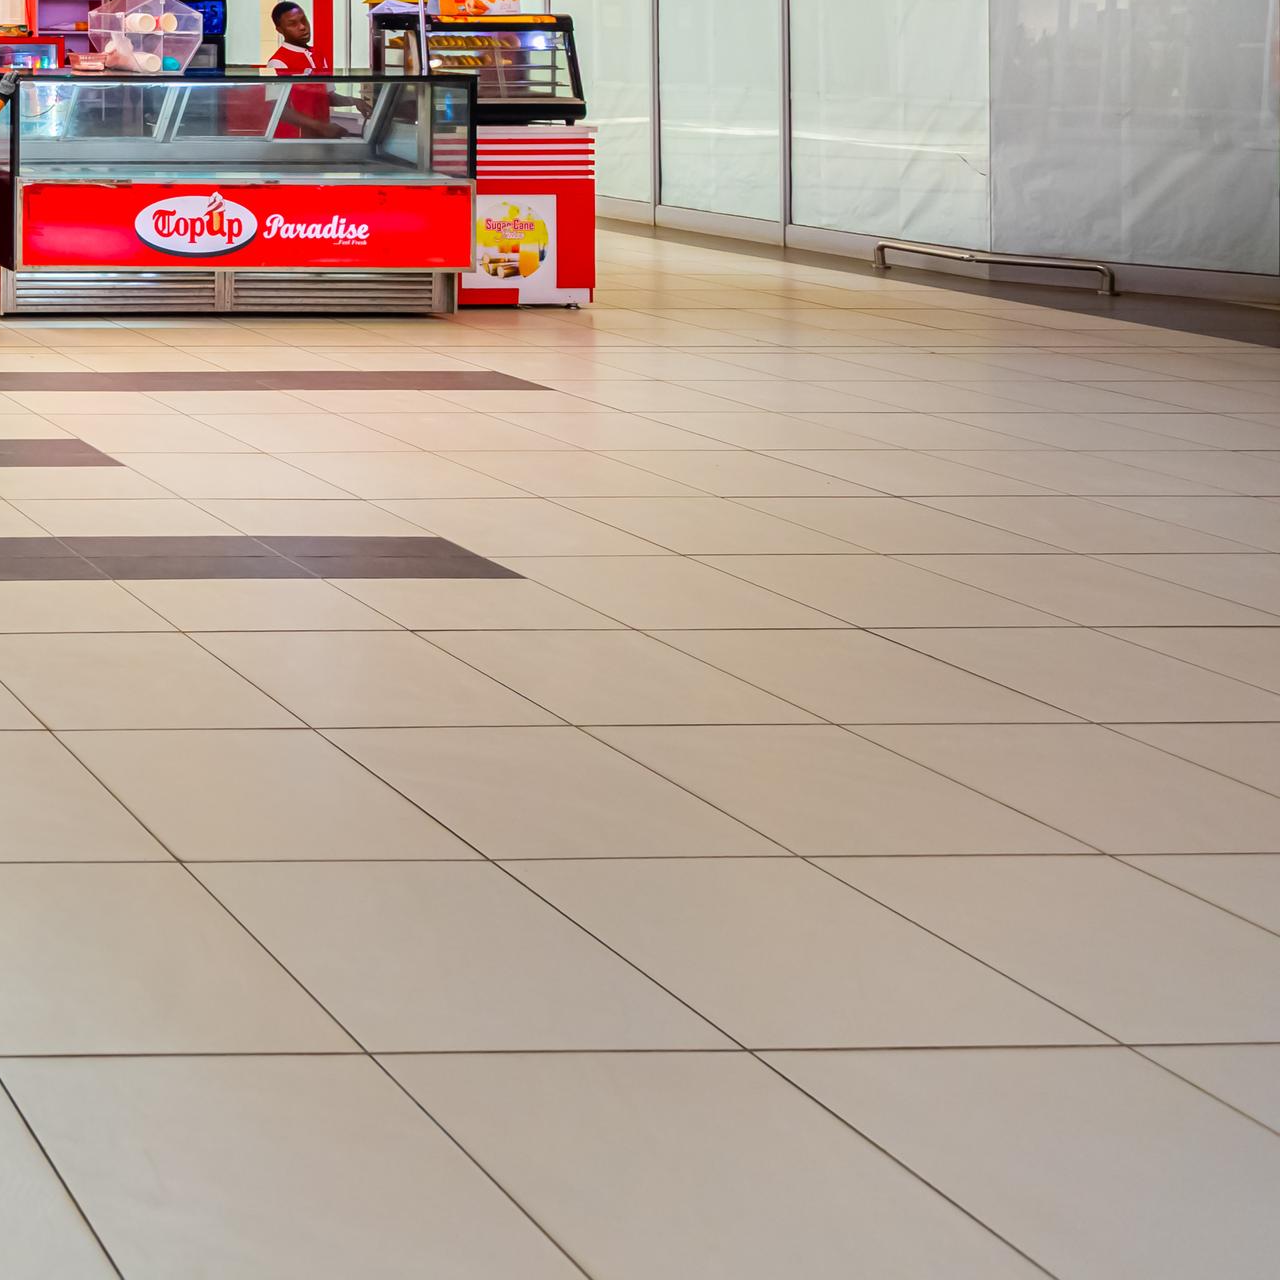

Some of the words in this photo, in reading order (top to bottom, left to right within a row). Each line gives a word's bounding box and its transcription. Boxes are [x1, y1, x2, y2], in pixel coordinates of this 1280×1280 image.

[263, 213, 370, 240] Paradise
[485, 217, 511, 232] Sugar
[513, 218, 535, 230] Cane
